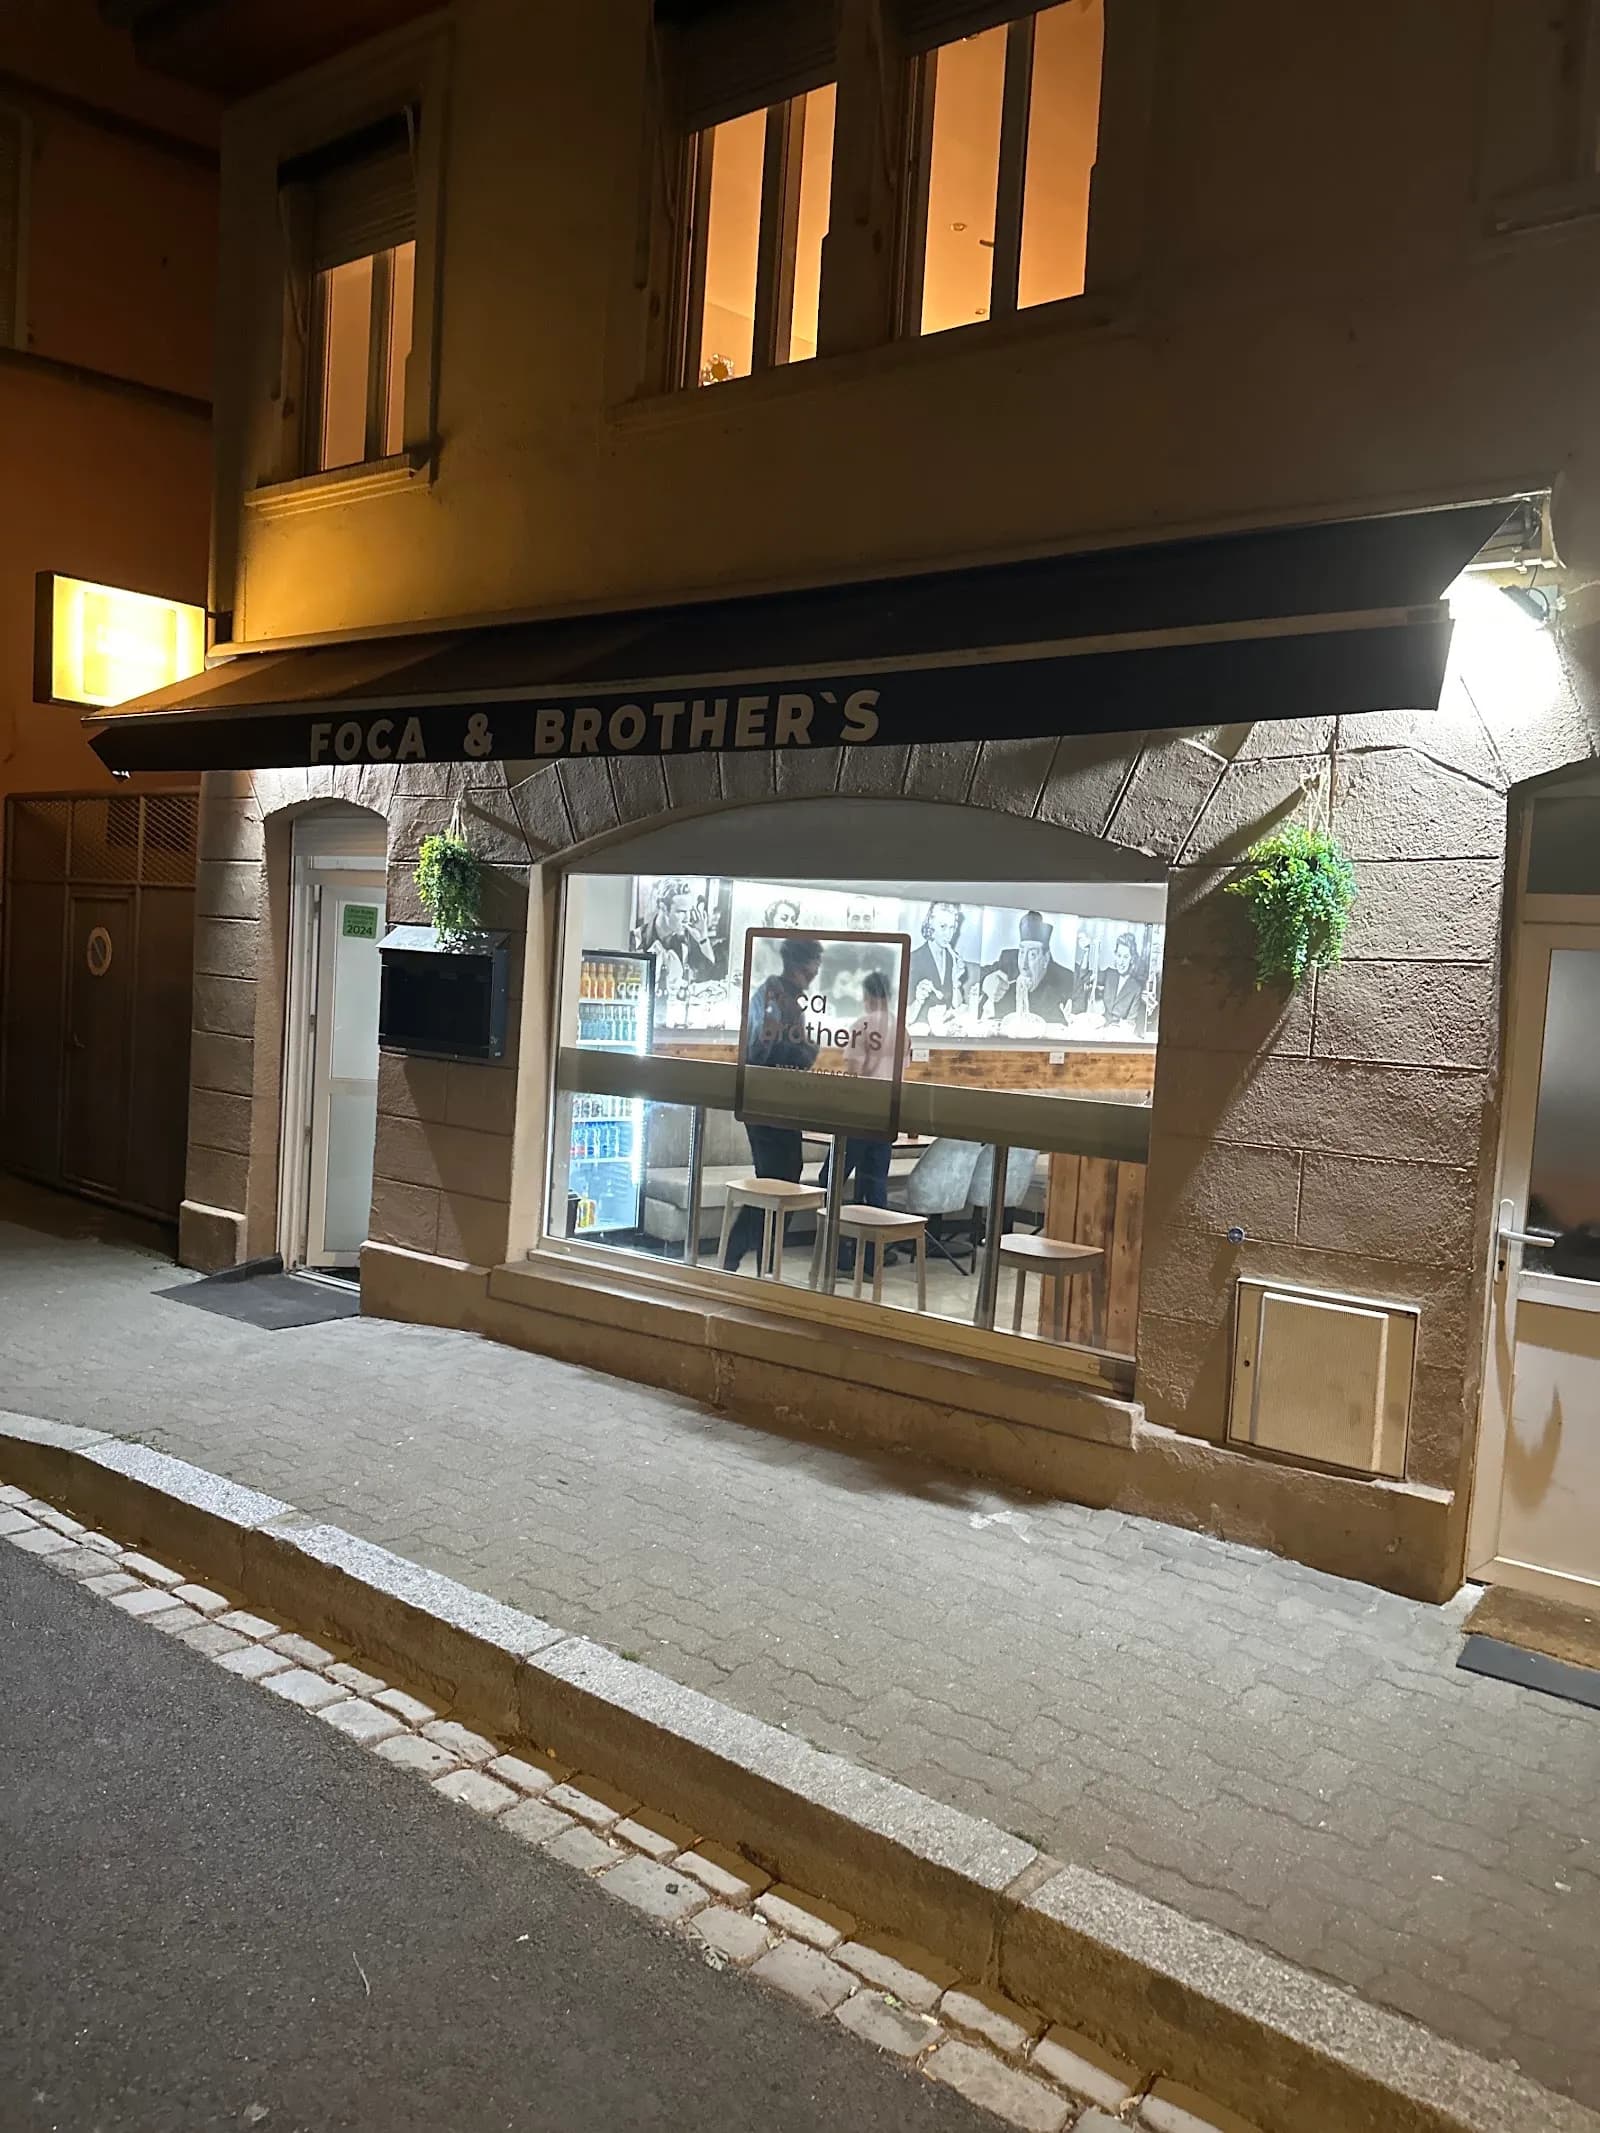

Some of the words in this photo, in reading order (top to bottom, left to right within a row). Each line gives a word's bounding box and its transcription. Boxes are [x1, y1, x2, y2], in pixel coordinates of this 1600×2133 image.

[310, 716, 426, 762] FOCA
[463, 712, 493, 757] &
[347, 925, 373, 936] 2024
